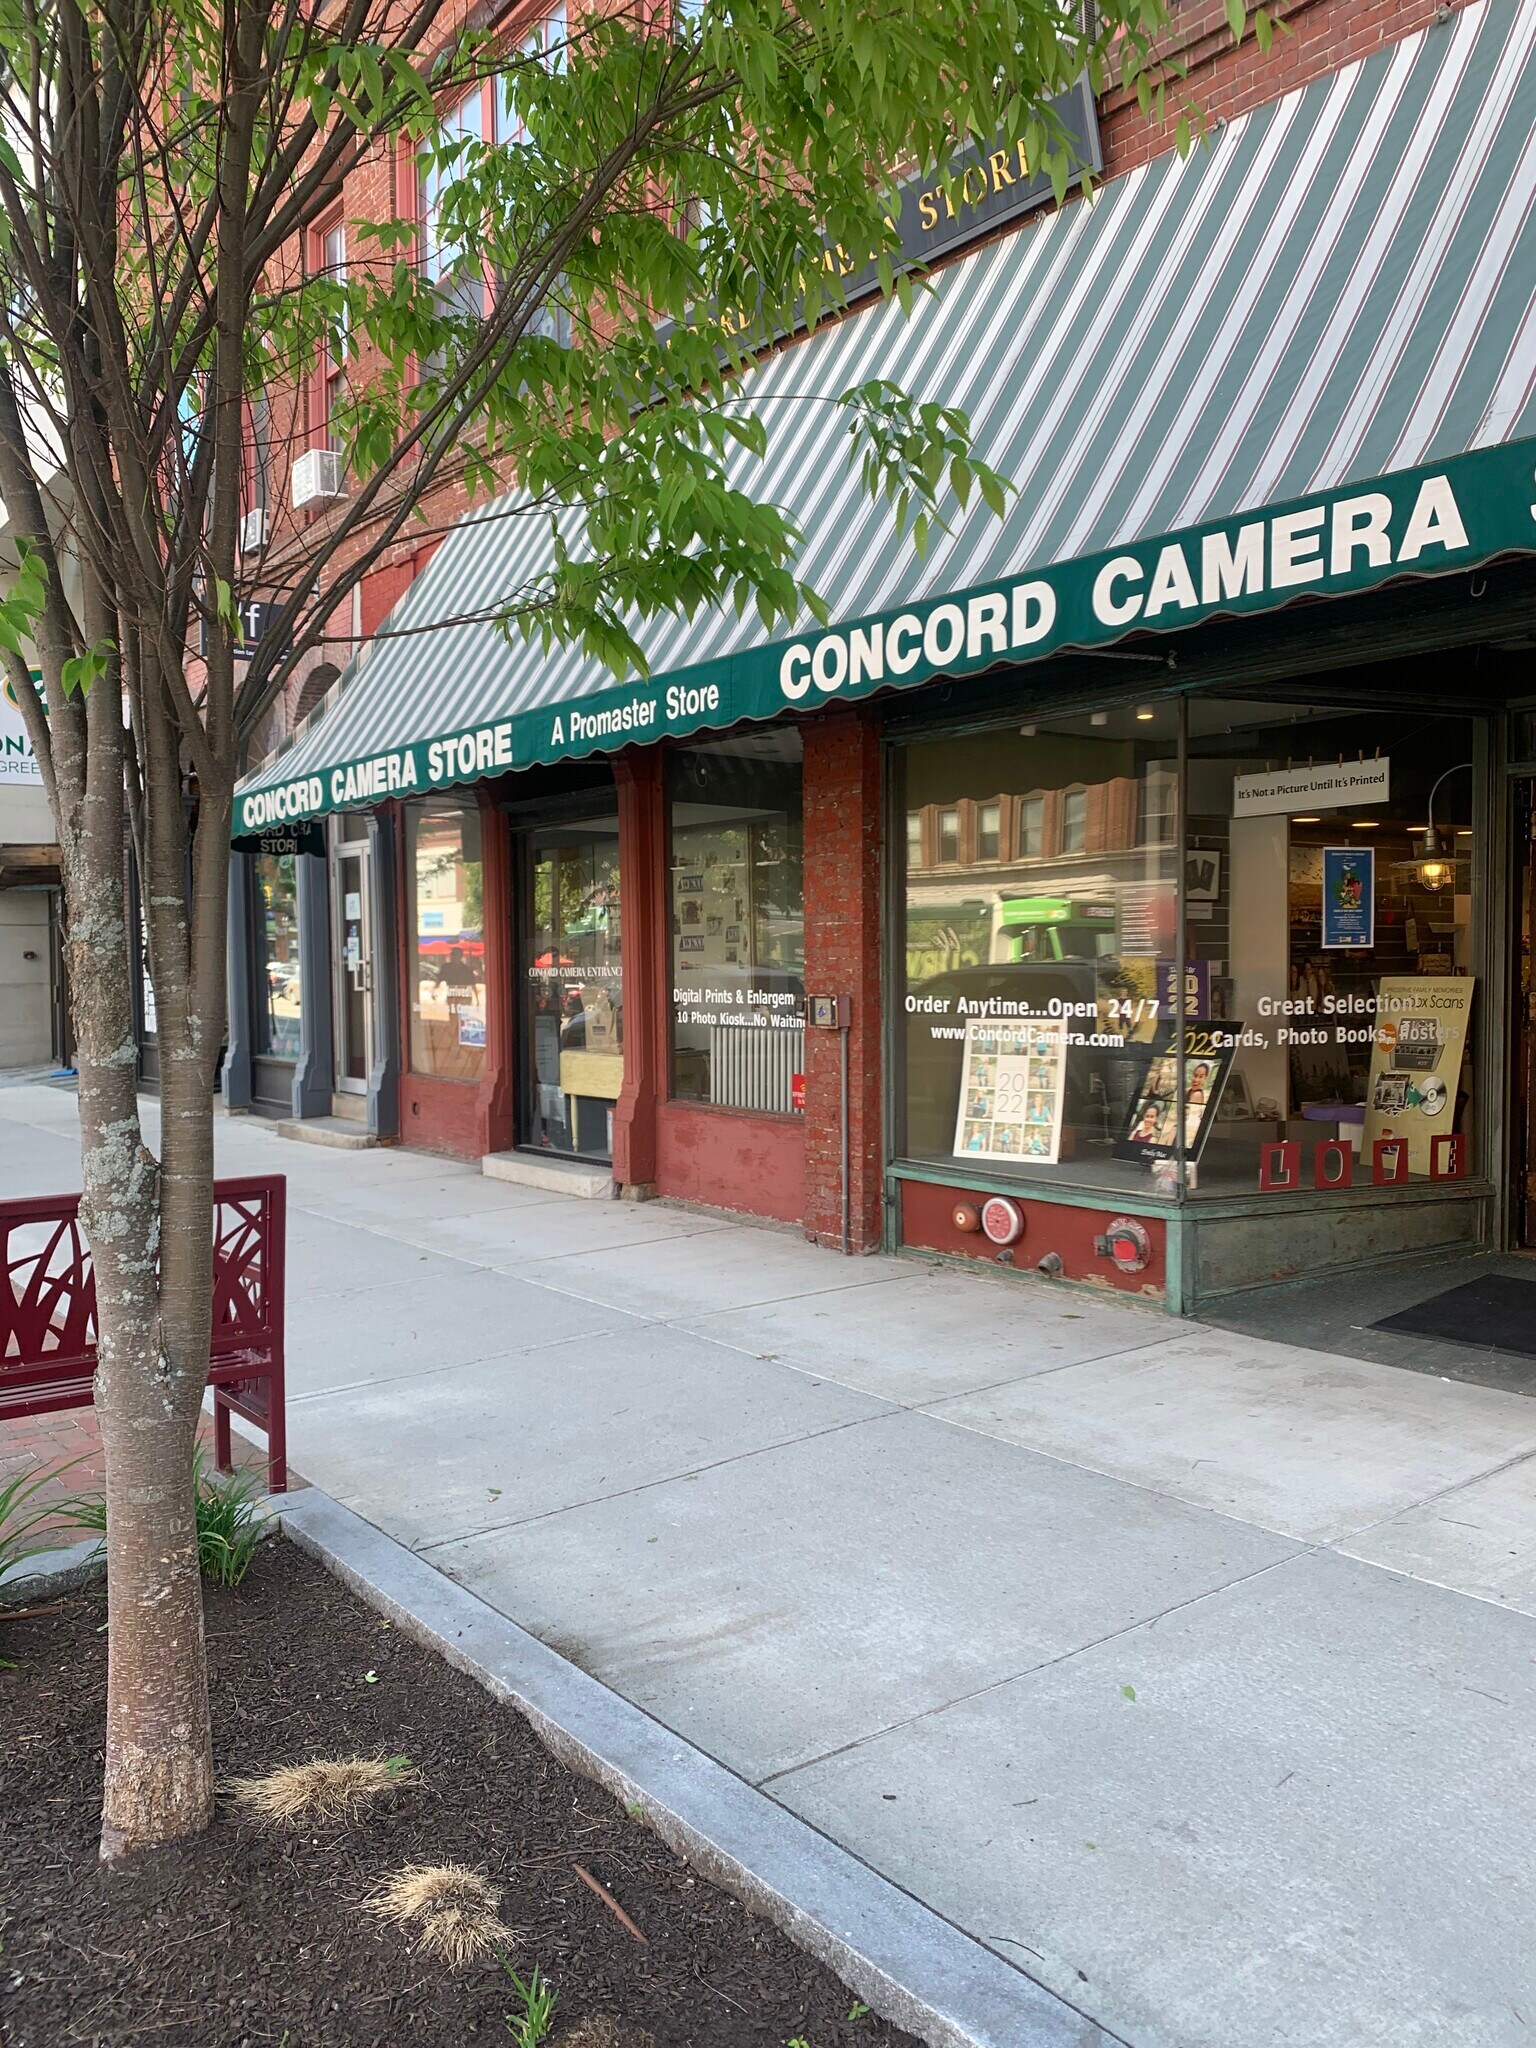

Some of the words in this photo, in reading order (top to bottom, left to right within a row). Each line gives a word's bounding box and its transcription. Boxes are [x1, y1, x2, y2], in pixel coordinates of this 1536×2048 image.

[780, 580, 1057, 700] CONCORD
[1092, 474, 1470, 627] CAMERA
[550, 717, 565, 746] A
[570, 698, 658, 742] Promaster
[665, 684, 719, 721] Store
[242, 776, 323, 828] CONCORD
[331, 750, 418, 804] CAMERA
[428, 722, 513, 782] STORE
[1238, 789, 1251, 800] It's
[1252, 788, 1269, 798] Not
[1277, 784, 1309, 796] Picture
[1310, 779, 1333, 791] Until
[1335, 777, 1348, 788] It's
[1349, 773, 1385, 787] Printed
[528, 967, 558, 977] CONCORD
[560, 967, 586, 977] CAMERA
[673, 988, 702, 1006] Digital
[705, 989, 733, 1004] Prints
[735, 989, 744, 1004] &
[1257, 997, 1315, 1017] Great
[1430, 994, 1465, 1009] Scans
[677, 1011, 688, 1024] 10
[691, 1012, 717, 1025] Photo
[905, 995, 950, 1014] Order
[1107, 998, 1160, 1023] 24/7
[930, 1024, 1125, 1048] www.ConcordCamera.com
[1211, 1030, 1269, 1050] Cards,
[1277, 1026, 1328, 1046] Photo
[998, 1072, 1026, 1093] 20
[996, 1093, 1024, 1114] 22
